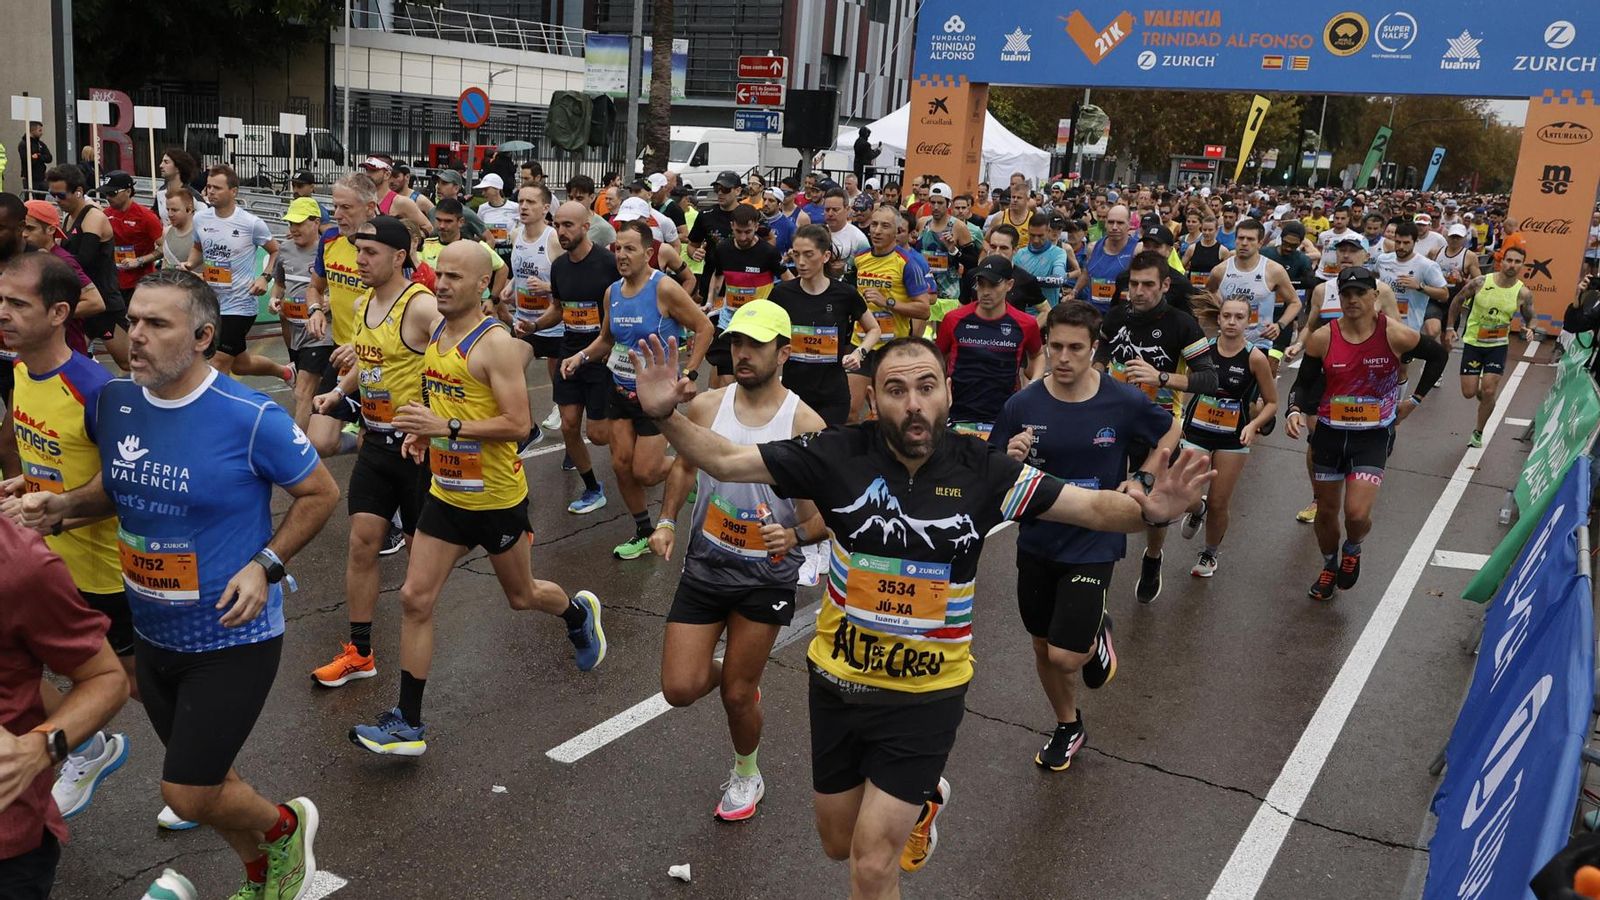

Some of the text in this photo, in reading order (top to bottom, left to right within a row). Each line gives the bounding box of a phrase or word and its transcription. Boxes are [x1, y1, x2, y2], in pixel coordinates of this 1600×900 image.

[1143, 9, 1221, 28] VALENCIA
[931, 42, 976, 51] TRINIDAD
[1094, 21, 1125, 57] 21K
[1142, 31, 1314, 49] TRINIDAD ALFONSO
[930, 51, 975, 60] ALFONSO
[1000, 52, 1031, 61] luanvi
[1162, 55, 1216, 67] ZURICH
[1512, 55, 1597, 72] ZURICH
[1440, 58, 1481, 70] luanvi
[766, 116, 778, 130] 14
[1250, 107, 1264, 131] 1
[1372, 134, 1388, 152] 2
[1431, 153, 1443, 166] 3
[803, 337, 822, 345] 5224
[1363, 357, 1389, 365] IMPETU
[439, 454, 460, 465] 7178
[142, 460, 190, 480] FERIA
[440, 467, 462, 478] OSCAR
[111, 467, 189, 493] VALENCIA
[149, 501, 189, 517] run!
[722, 518, 748, 535] 3995
[719, 531, 746, 547] CALSU
[131, 554, 164, 571] 3752
[918, 567, 945, 576] ZURICH
[146, 576, 181, 589] TANIA
[877, 579, 916, 597] 3534
[875, 599, 913, 616] JÚ-XA
[875, 615, 901, 624] luanvi
[831, 617, 945, 678] ALT DE LA CREU
